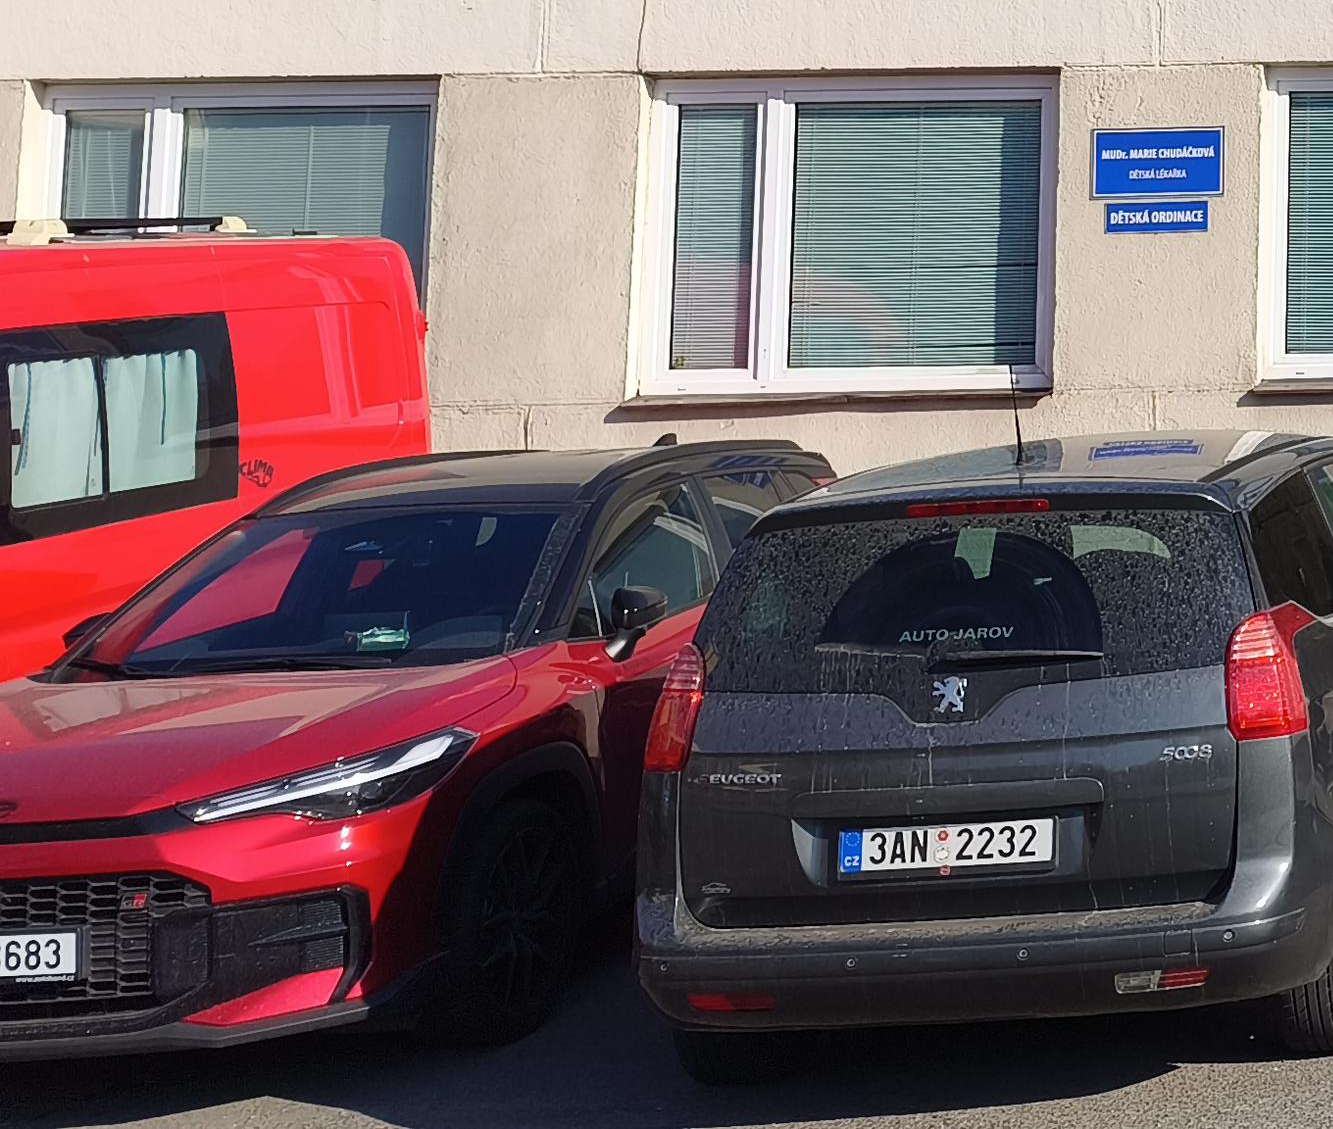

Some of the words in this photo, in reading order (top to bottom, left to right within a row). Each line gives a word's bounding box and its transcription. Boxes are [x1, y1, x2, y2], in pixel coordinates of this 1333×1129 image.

[1101, 149, 1129, 160] MUDr.
[1129, 148, 1158, 159] MARIE
[1158, 145, 1215, 158] CHUDÁČKOVÁ
[1129, 168, 1155, 179] DĚTSKÁ
[1156, 168, 1187, 179] LÉKAŘKA
[1110, 209, 1150, 225] DĚTSKÁ
[1151, 209, 1204, 223] ORDINACE
[898, 628, 949, 642] AUTO
[1159, 744, 1213, 763] 5008
[869, 829, 929, 865] 3AN
[955, 824, 1038, 861] 2232
[843, 855, 860, 867] CZ
[0, 938, 61, 972] 683
